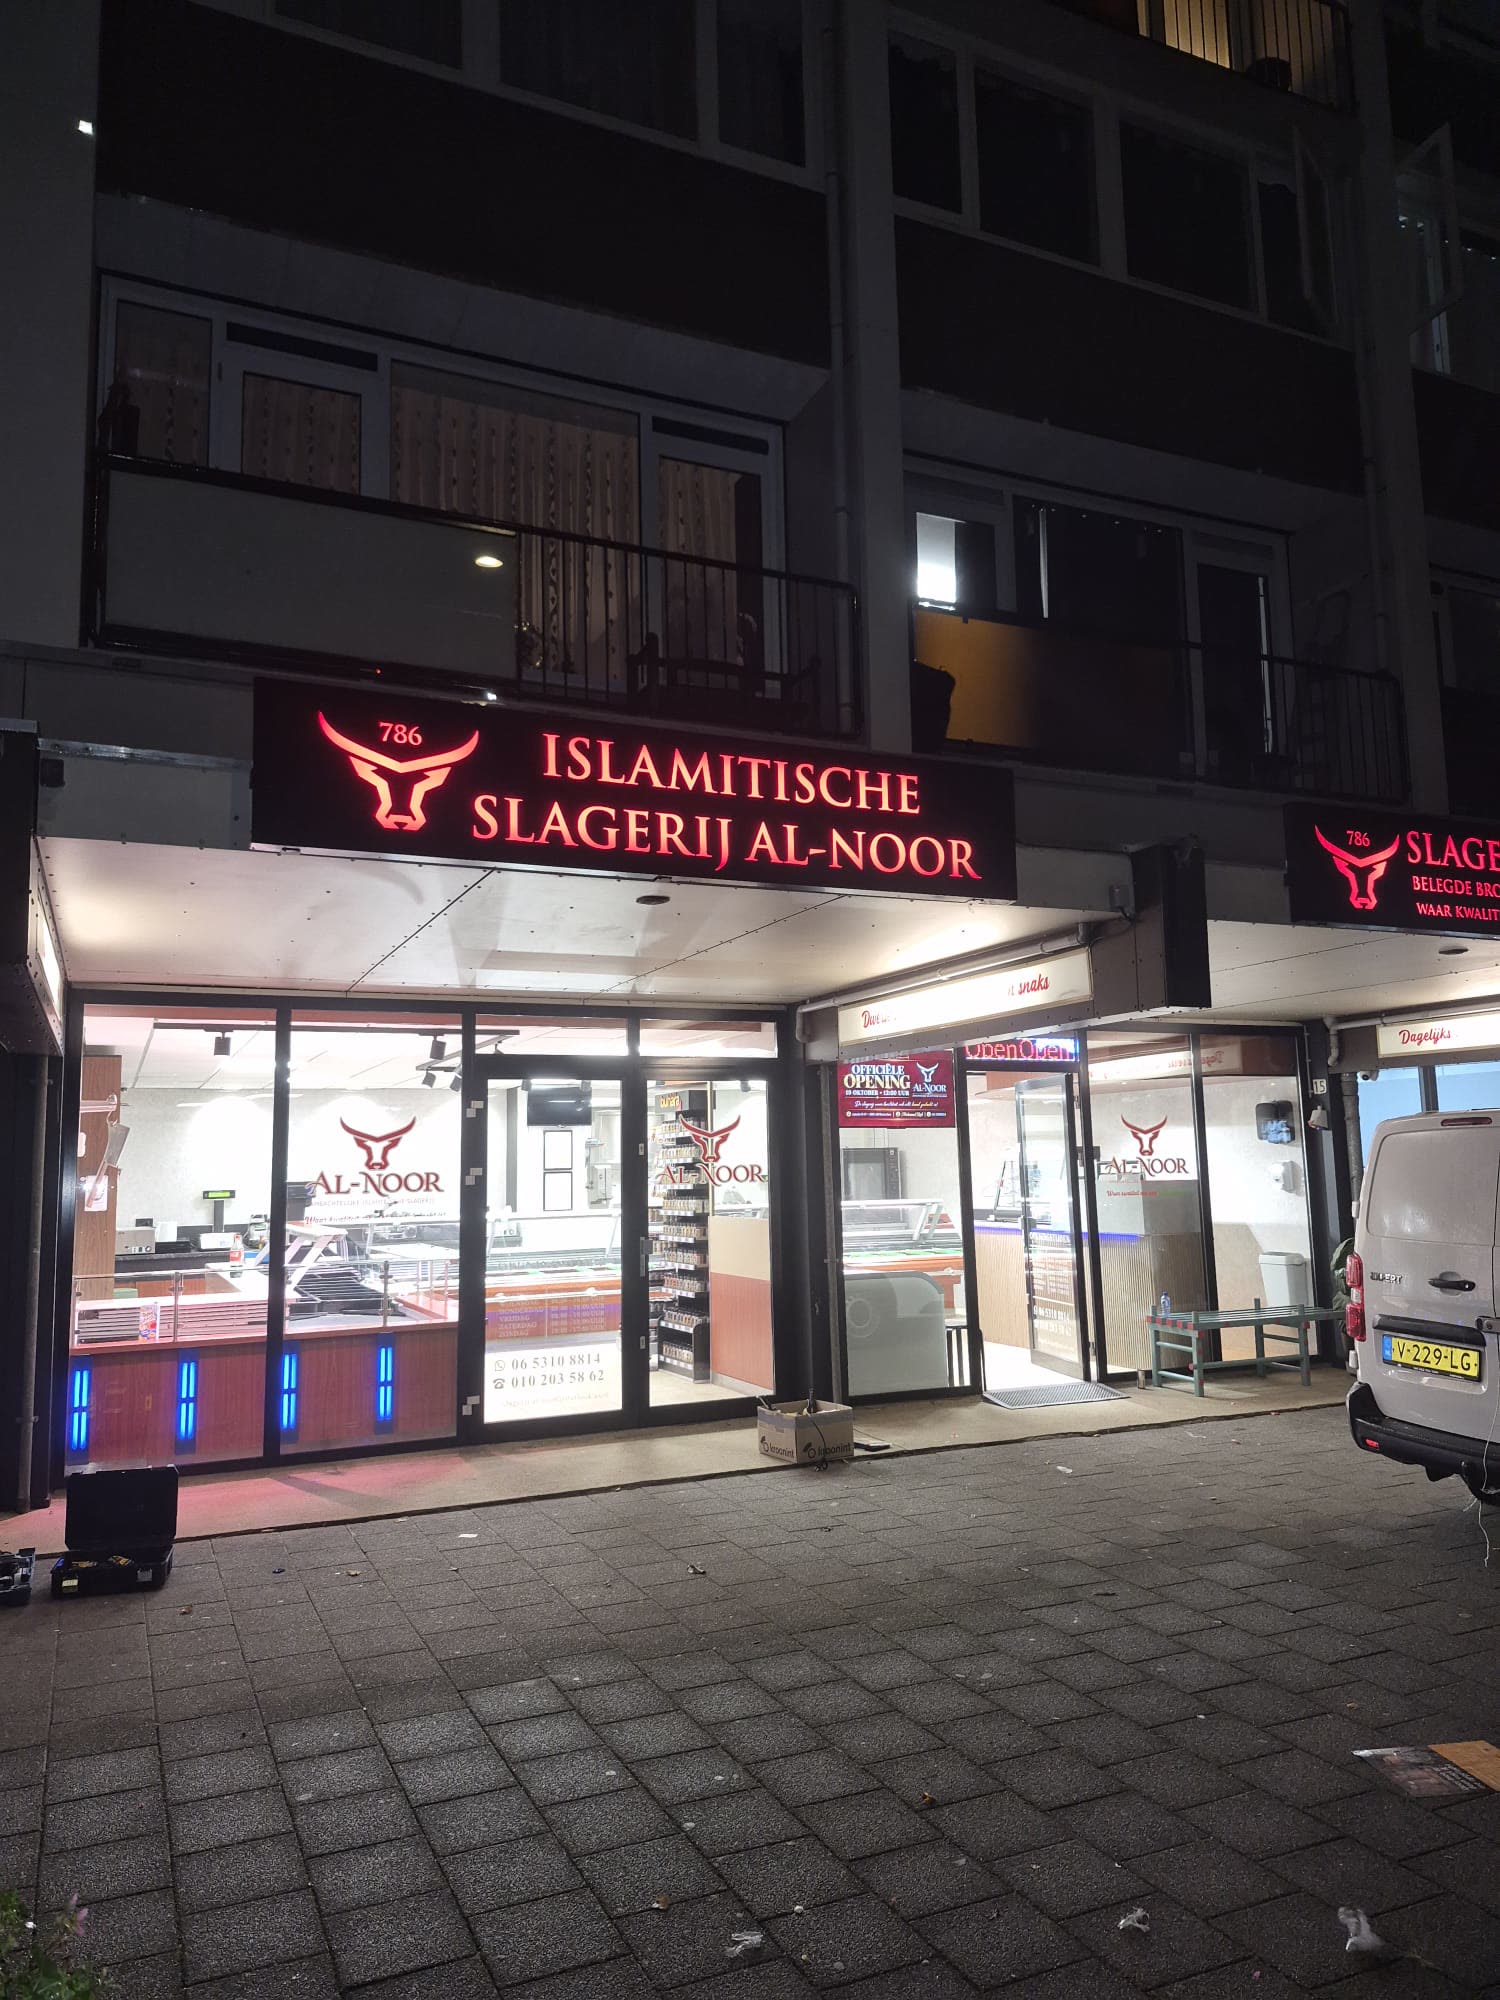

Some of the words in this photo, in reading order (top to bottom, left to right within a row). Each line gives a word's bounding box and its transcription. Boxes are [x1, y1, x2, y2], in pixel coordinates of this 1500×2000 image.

[379, 721, 422, 746] 786
[543, 733, 921, 815] ISLAMITISCHE
[473, 795, 733, 870] SLAGERIJ
[745, 821, 982, 880] AL-NOOR
[1346, 830, 1371, 847] 786
[1407, 830, 1500, 871] SLAGE
[1412, 875, 1472, 895] BELEGDE
[1416, 902, 1452, 917] WAAR
[1455, 905, 1500, 920] KWALIT
[1018, 974, 1050, 996] snaks
[1398, 1028, 1451, 1046] Dagelijks
[843, 1074, 911, 1089] OPENING
[912, 1083, 947, 1094] AL-NOOR
[1314, 1080, 1326, 1093] 15
[656, 1164, 766, 1187] AL-NOOR
[1105, 1156, 1189, 1177] AL-NOOR
[305, 1170, 445, 1198] AL-NOOR
[511, 1358, 527, 1370] 06
[532, 1356, 564, 1369] 5310
[1397, 1341, 1471, 1372] V-229-LG
[511, 1375, 536, 1388] 010
[540, 1373, 564, 1386] 203
[569, 1371, 584, 1384] 58
[589, 1369, 604, 1382] 62
